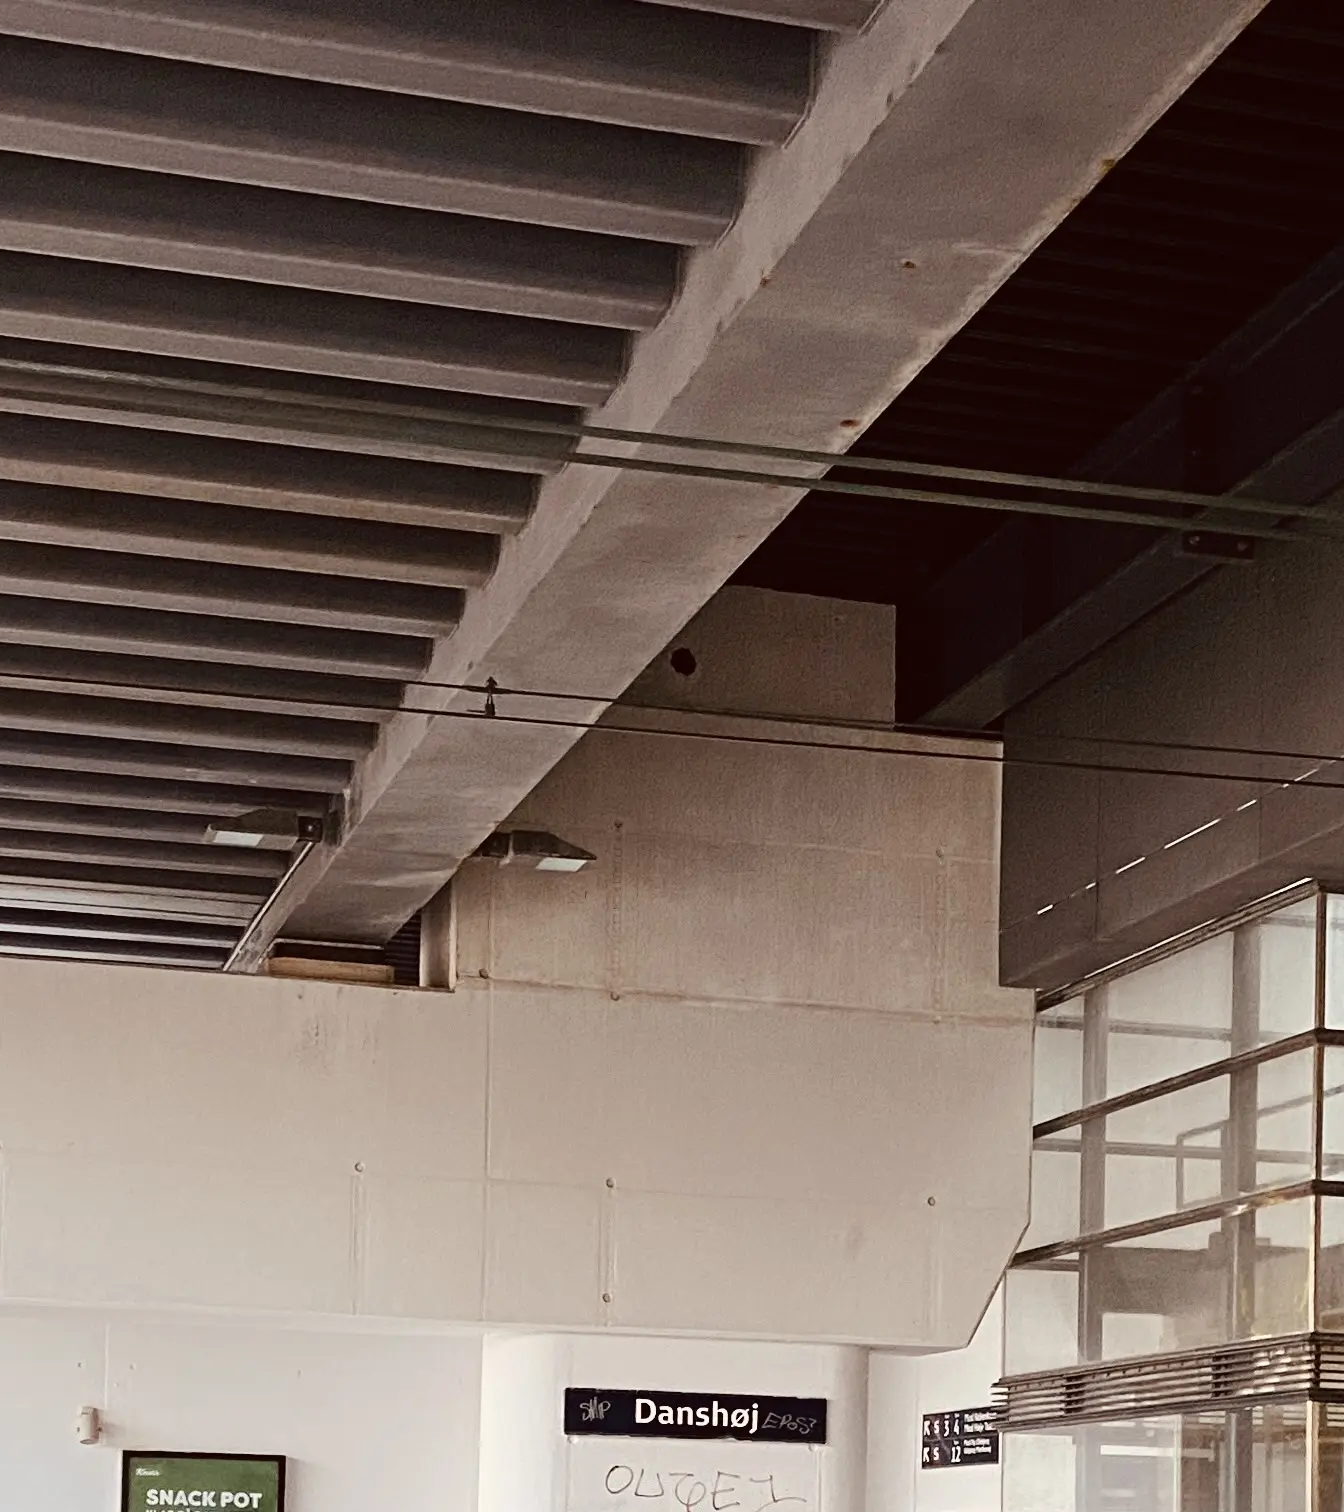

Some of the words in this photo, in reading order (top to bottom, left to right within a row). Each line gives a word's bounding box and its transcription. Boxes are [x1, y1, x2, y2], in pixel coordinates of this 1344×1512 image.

[634, 1399, 759, 1434] Danshøj
[146, 1488, 216, 1507] SNACK
[220, 1491, 263, 1509] POT
